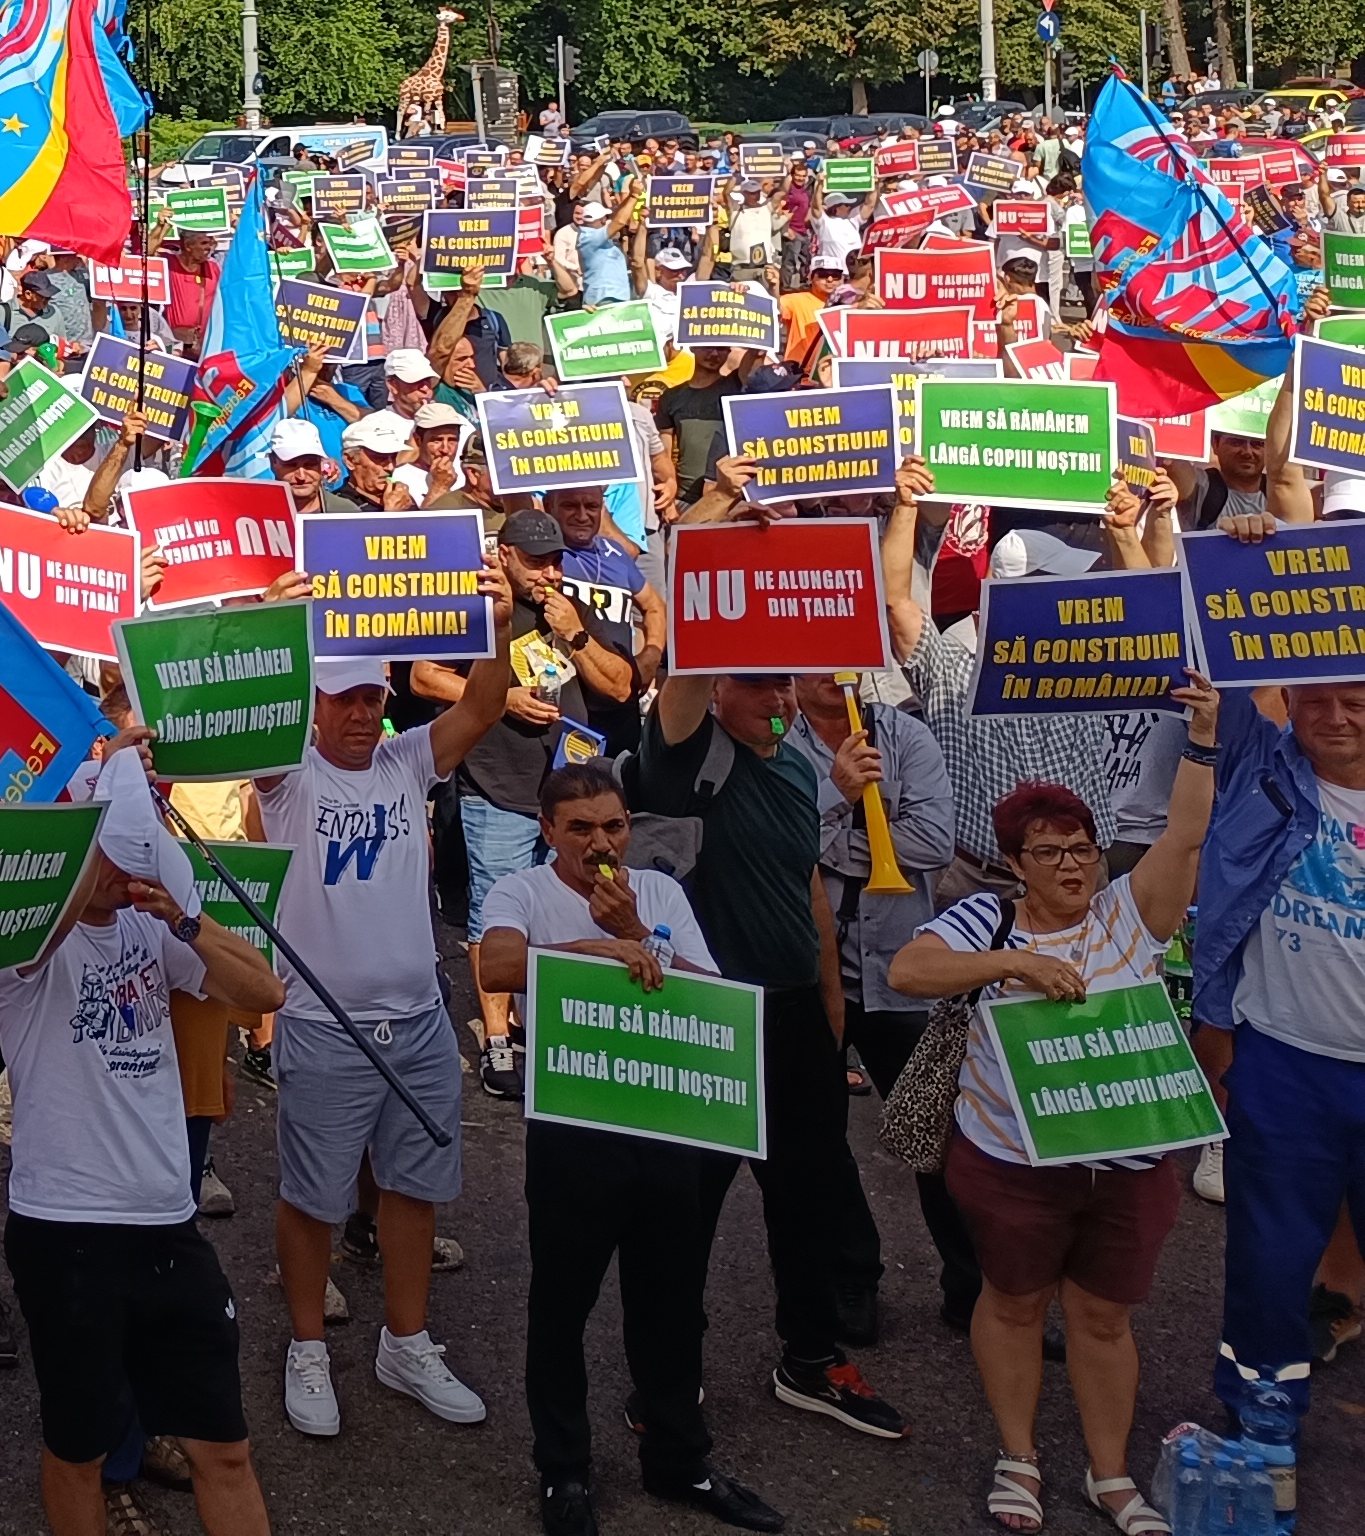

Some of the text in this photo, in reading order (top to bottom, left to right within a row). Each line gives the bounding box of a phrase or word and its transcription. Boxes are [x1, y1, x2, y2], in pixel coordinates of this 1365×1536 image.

[459, 219, 490, 233] VREM
[431, 235, 512, 251] SĂ CONSTRUIM
[710, 290, 744, 304] VREM
[683, 306, 772, 326] SĂ CONSTRUIM
[705, 323, 765, 341] ROMÂNIA!
[784, 407, 841, 428] VREM
[940, 408, 1089, 434] VREM SĂ RĂMÂNEM
[742, 429, 887, 459] SĂ CONSTRUIM
[756, 459, 878, 486] ÎN ROMÂNIA!
[930, 444, 1101, 476] LÂNGĂ COPIII NOȘTRI!
[365, 535, 426, 560] VREM
[312, 570, 478, 599] SĂ CONSTRUIM
[683, 570, 747, 621] NU
[754, 570, 863, 596] NE ALUNGAȚI
[768, 594, 855, 622] DIN ȚARĂ!
[1058, 597, 1125, 626] VREM
[325, 609, 466, 638] ÎN ROMÂNIA!
[994, 633, 1180, 665] SĂ CONSTRUIM
[155, 647, 293, 690] VREM SĂ RĂMÂNEM
[1002, 673, 1169, 700] ÎN ROMÂNIA!
[204, 707, 247, 739] COPIII
[249, 700, 301, 735] NOȘTRI!
[561, 998, 734, 1052] VREM SĂ RĂMÂNEM
[1027, 1035, 1083, 1065] VREM
[1084, 1027, 1115, 1057] SĂ
[547, 1045, 747, 1106] LÂNGĂ COPIII NOȘTRI!
[1031, 1085, 1096, 1117] LÂNGĂ
[1097, 1077, 1158, 1107] COPIII
